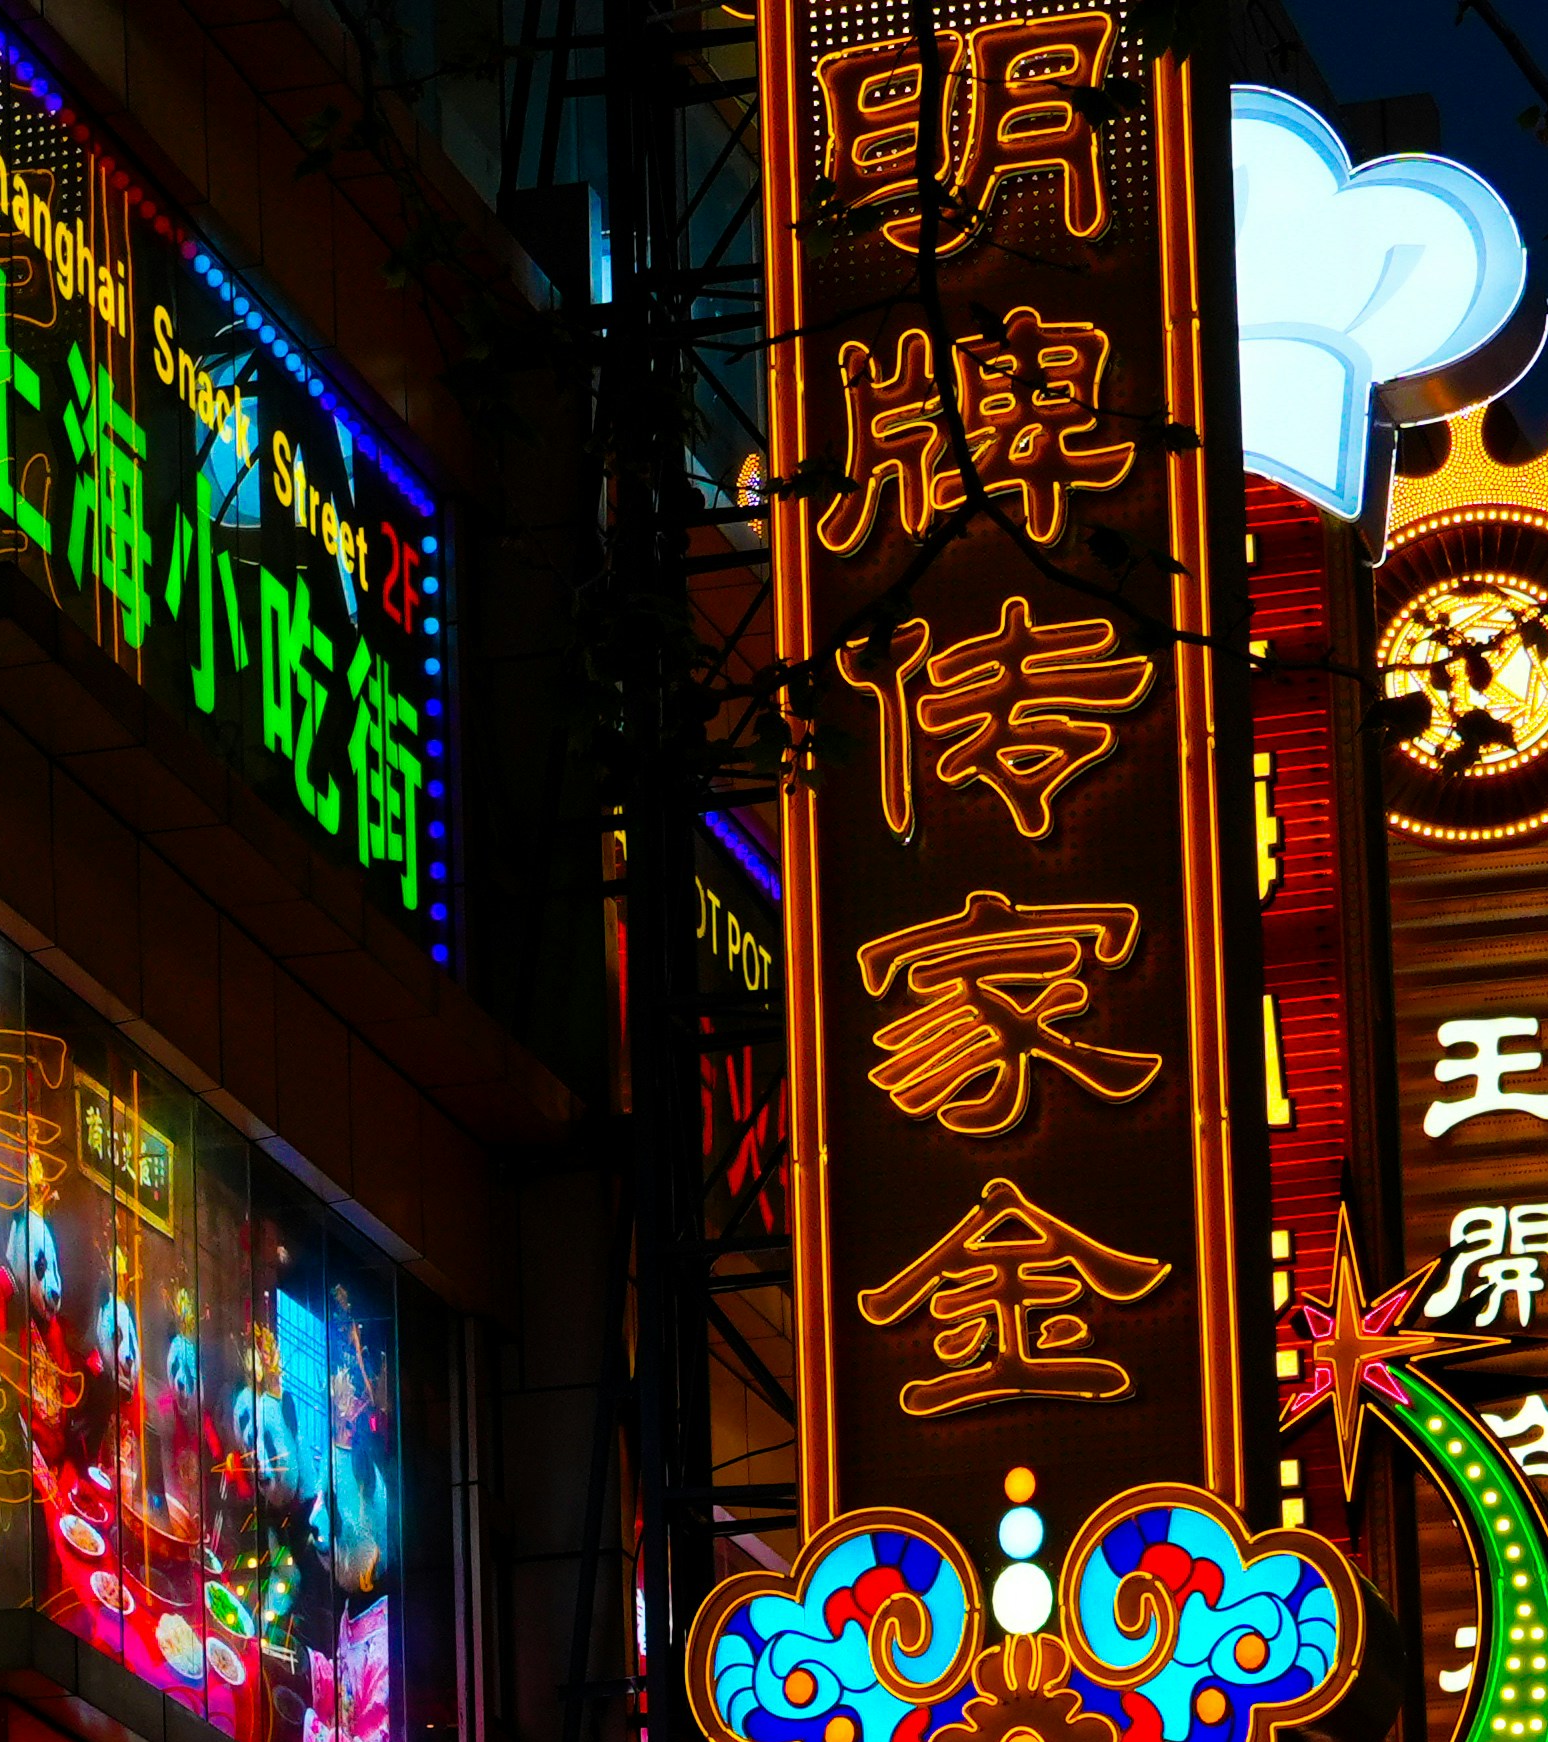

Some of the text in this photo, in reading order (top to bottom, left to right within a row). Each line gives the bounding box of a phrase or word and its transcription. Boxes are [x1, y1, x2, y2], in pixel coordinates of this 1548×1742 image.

[153, 304, 254, 470] Snack
[272, 429, 371, 594] Street
[380, 522, 421, 635] 2F
[815, 10, 1173, 1417] 明牌传家金
[728, 910, 772, 990] POT
